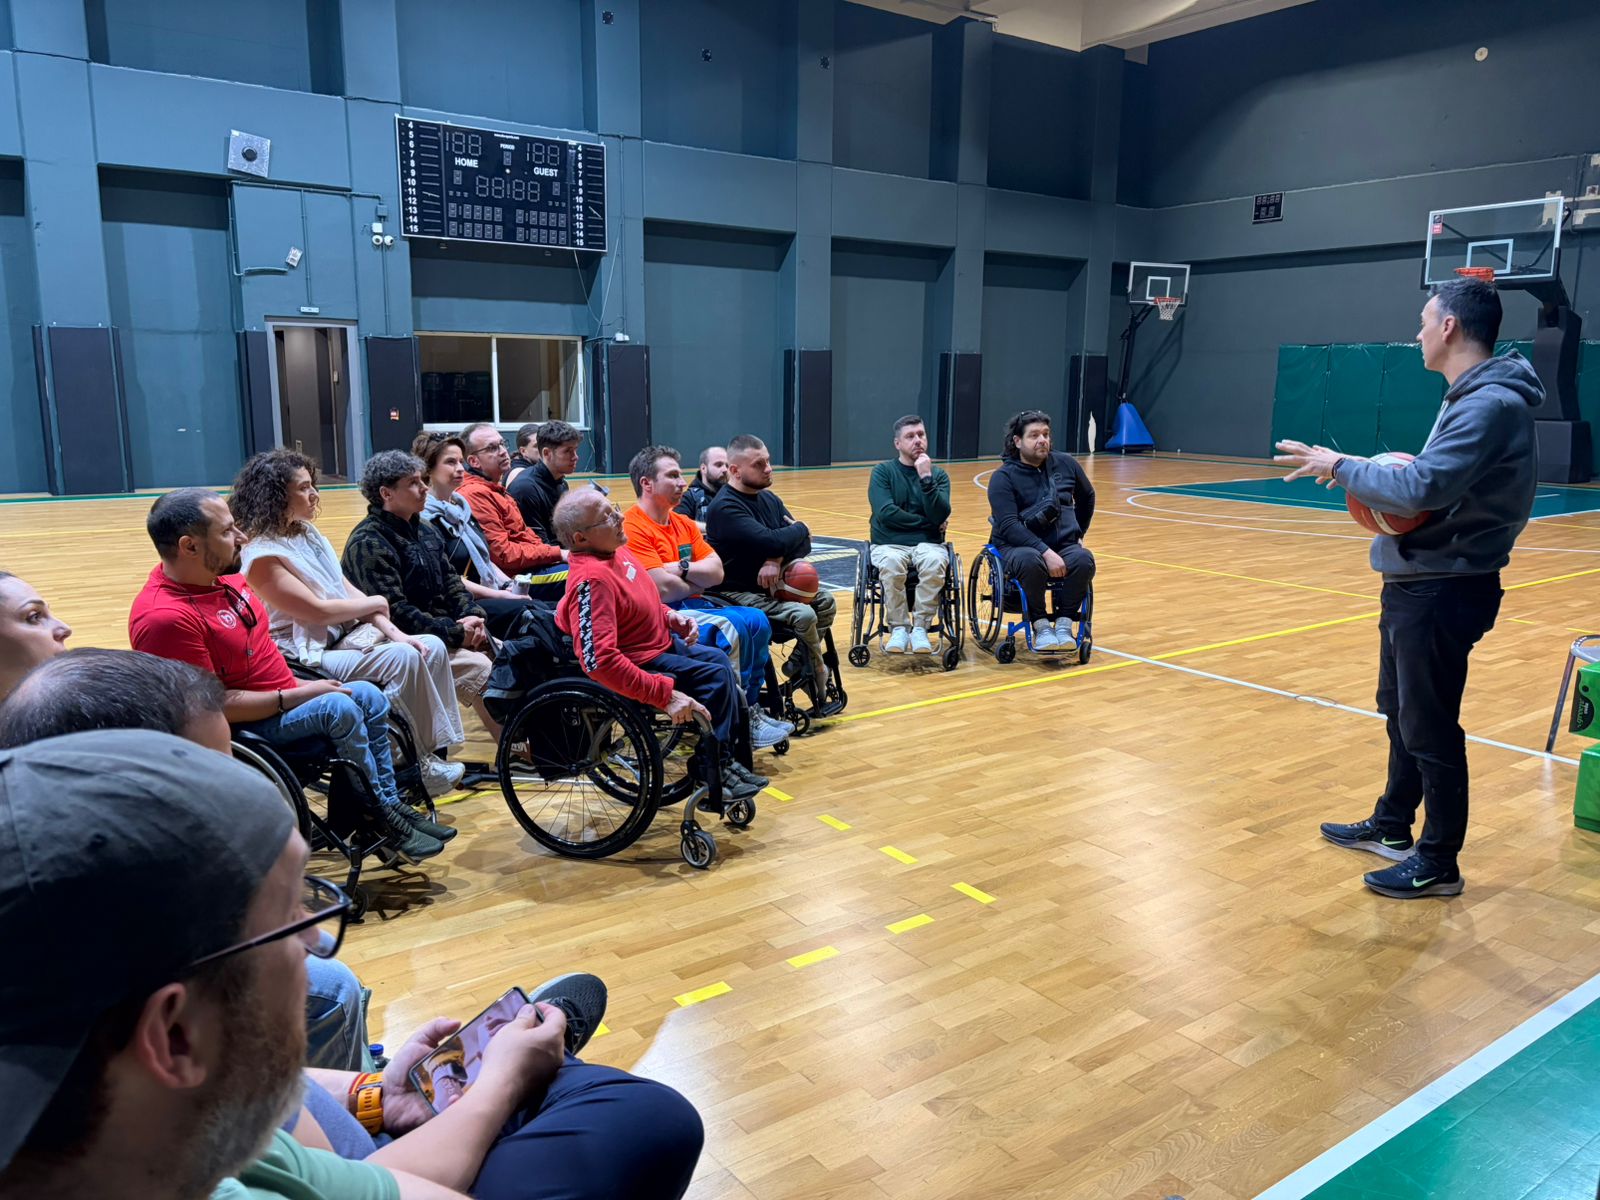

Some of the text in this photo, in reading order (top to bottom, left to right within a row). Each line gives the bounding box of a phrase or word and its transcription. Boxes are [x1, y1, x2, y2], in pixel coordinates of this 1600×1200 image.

[408, 121, 414, 129] 4
[408, 130, 414, 139] 5
[409, 140, 415, 148] 6
[577, 144, 582, 152] 4
[409, 149, 415, 158] 7
[577, 153, 583, 161] 5
[410, 159, 415, 167] 8
[454, 157, 479, 168] HOME
[578, 161, 583, 169] 6
[410, 168, 416, 177] 9
[533, 166, 559, 178] GUEST
[407, 177, 416, 186] 10
[408, 187, 416, 195] 11
[578, 187, 583, 195] 9
[408, 196, 417, 205] 12
[408, 206, 418, 214] 13
[575, 204, 583, 212] 11
[409, 215, 418, 223] 14
[575, 213, 583, 221] 12
[409, 224, 419, 233] 15
[575, 221, 584, 229] 13
[575, 238, 584, 246] 15
